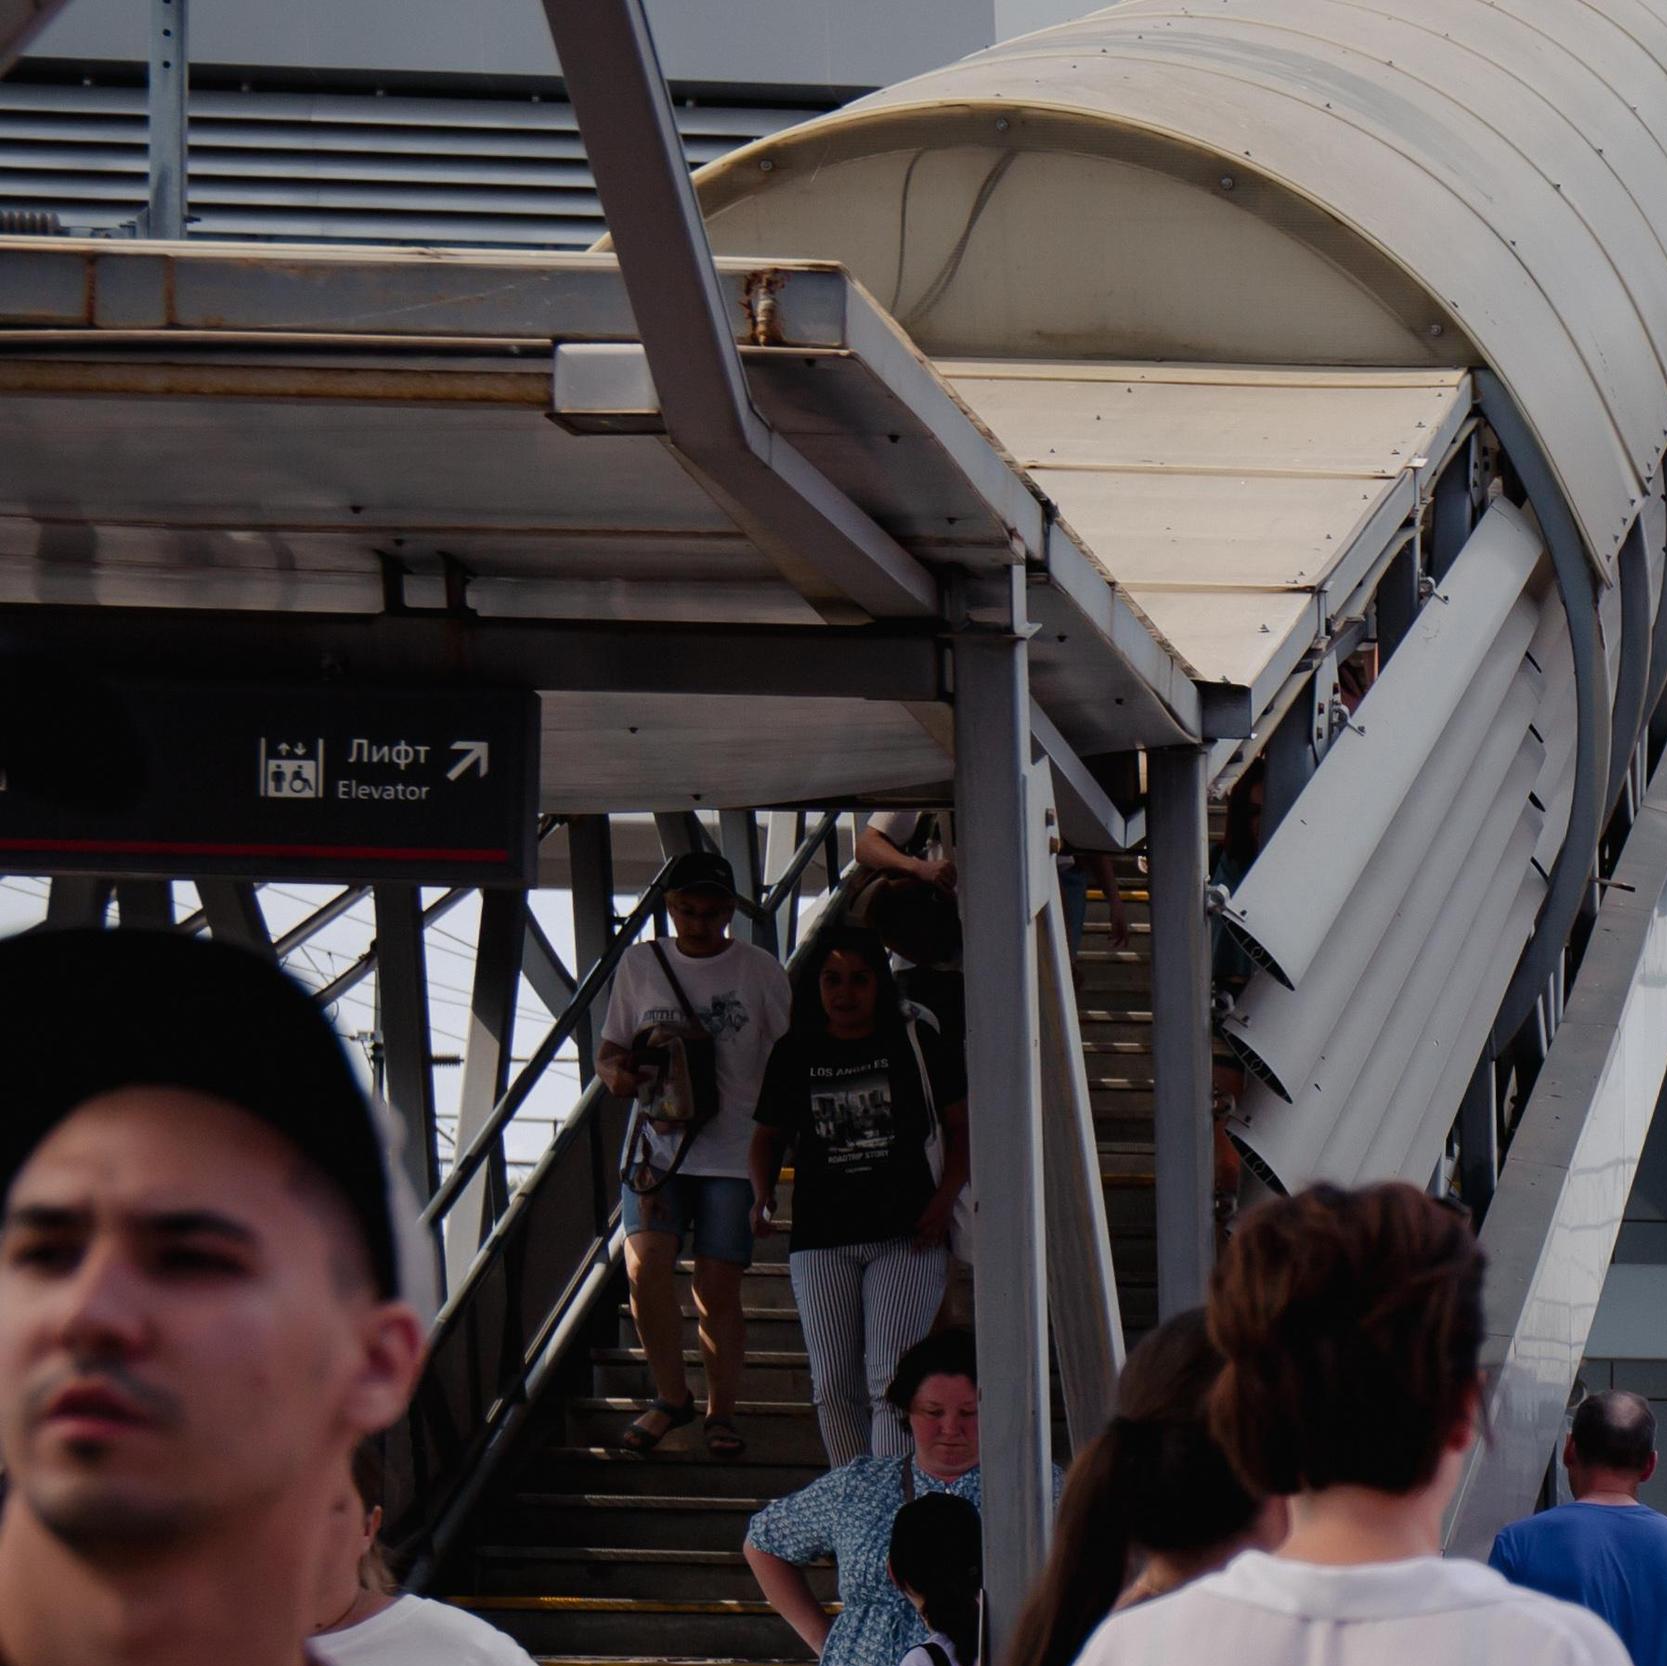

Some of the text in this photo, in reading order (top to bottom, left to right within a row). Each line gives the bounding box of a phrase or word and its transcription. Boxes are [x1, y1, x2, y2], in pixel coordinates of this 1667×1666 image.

[347, 738, 432, 770] Лифт
[337, 779, 432, 801] Elevator
[809, 1066, 833, 1078] LOS
